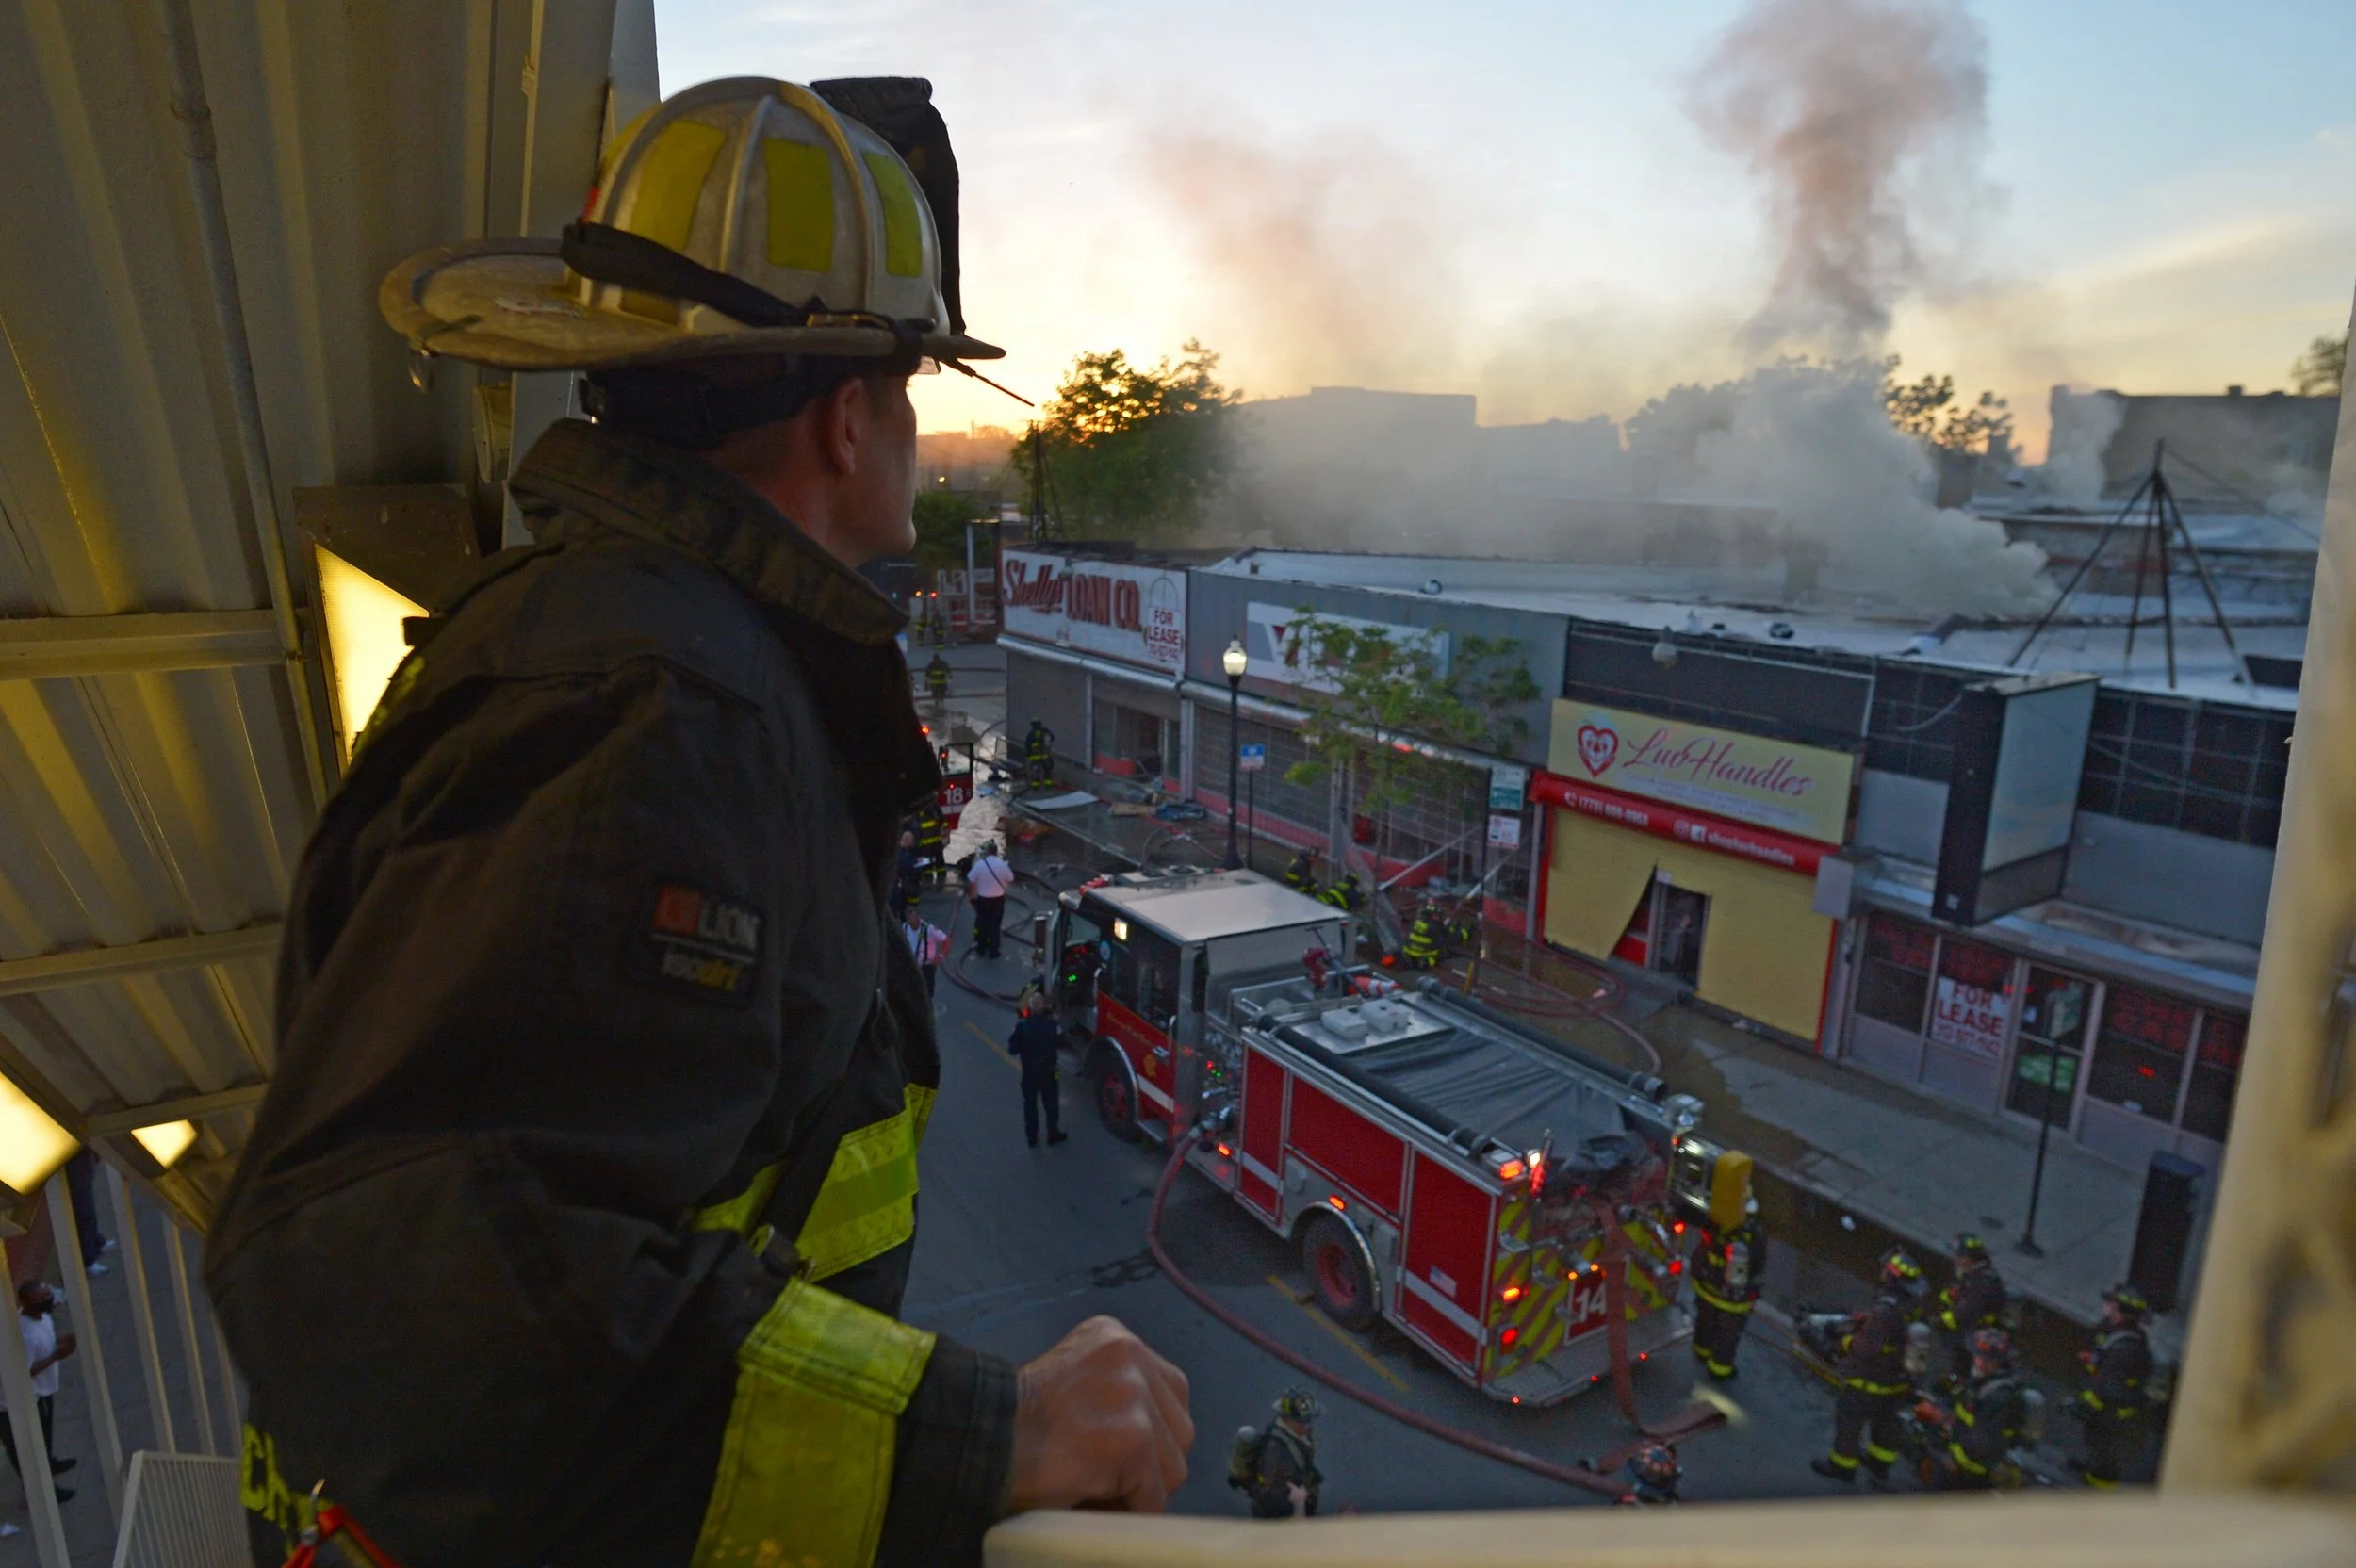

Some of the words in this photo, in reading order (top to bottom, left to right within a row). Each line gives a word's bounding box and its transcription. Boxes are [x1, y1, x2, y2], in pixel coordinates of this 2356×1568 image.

[1067, 574, 1111, 626] LOAN
[1153, 610, 1173, 625] FOR
[1148, 626, 1179, 645] LEASE
[944, 787, 963, 804] 18
[1953, 983, 1992, 1009] FOR
[1938, 1002, 2003, 1036] LEASE
[1575, 1283, 1607, 1323] 14
